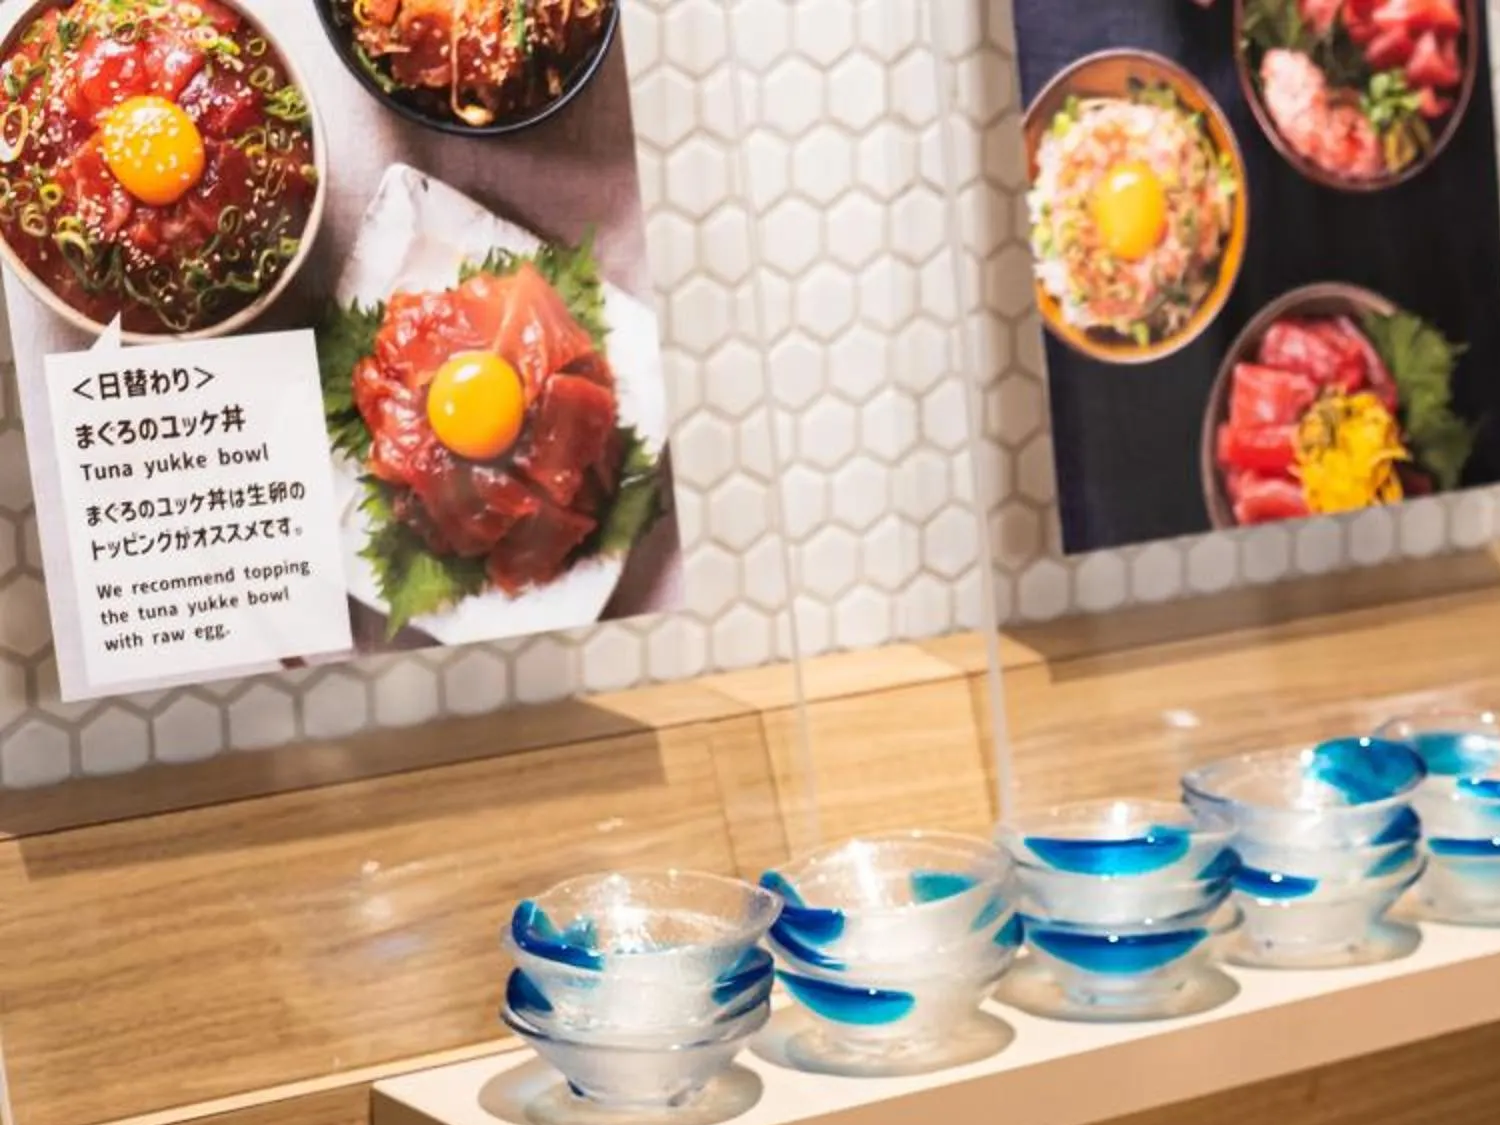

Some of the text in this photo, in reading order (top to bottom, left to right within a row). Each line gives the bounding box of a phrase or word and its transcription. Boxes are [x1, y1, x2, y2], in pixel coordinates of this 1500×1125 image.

[75, 404, 246, 450] まぐろのユッケ丼
[80, 443, 269, 482] Tuna yukke bowl
[86, 481, 305, 527] まぐろのユッケ丼は生卵の
[91, 516, 303, 560] トッピングがオススメです。
[97, 559, 312, 600] We recommend topping
[100, 586, 290, 626] the tuna yukke bowl
[104, 621, 231, 652] with raw egg.
